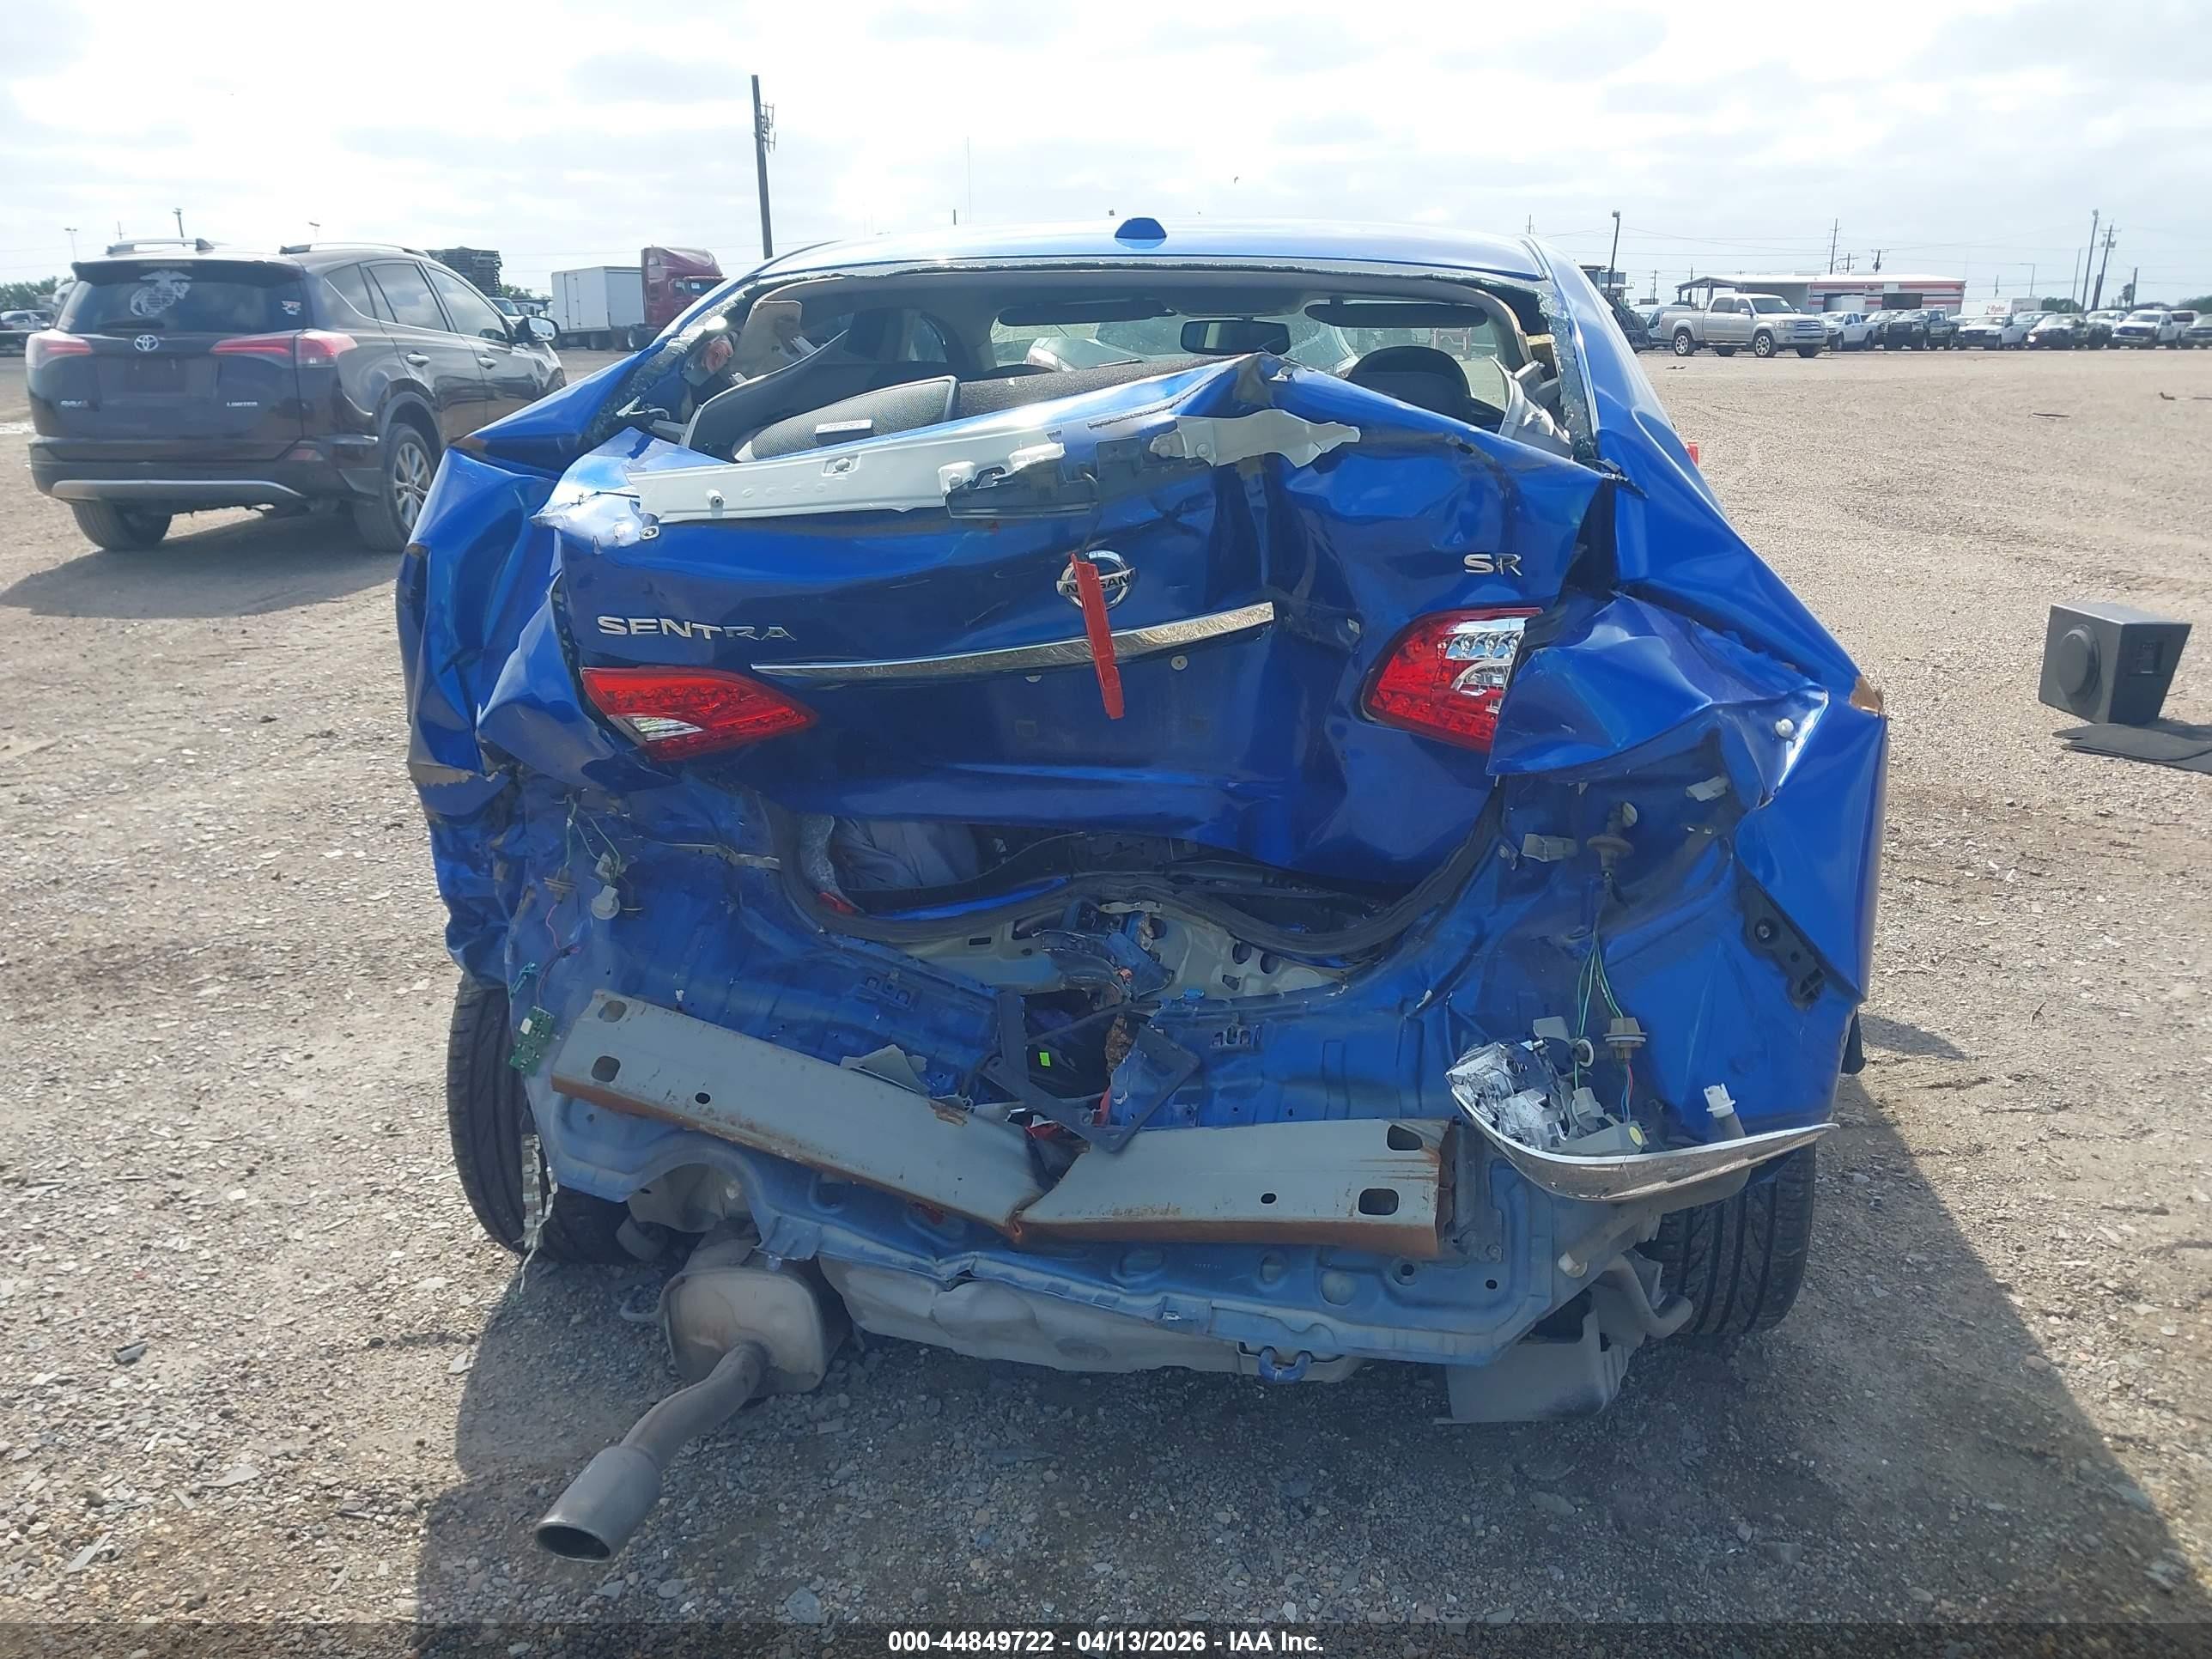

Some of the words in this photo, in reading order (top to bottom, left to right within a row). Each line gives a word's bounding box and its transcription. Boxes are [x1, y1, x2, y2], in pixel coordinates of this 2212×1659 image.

[1464, 553, 1522, 576] SR
[1066, 574, 1129, 592] NSAN
[597, 616, 798, 641] SENTRA
